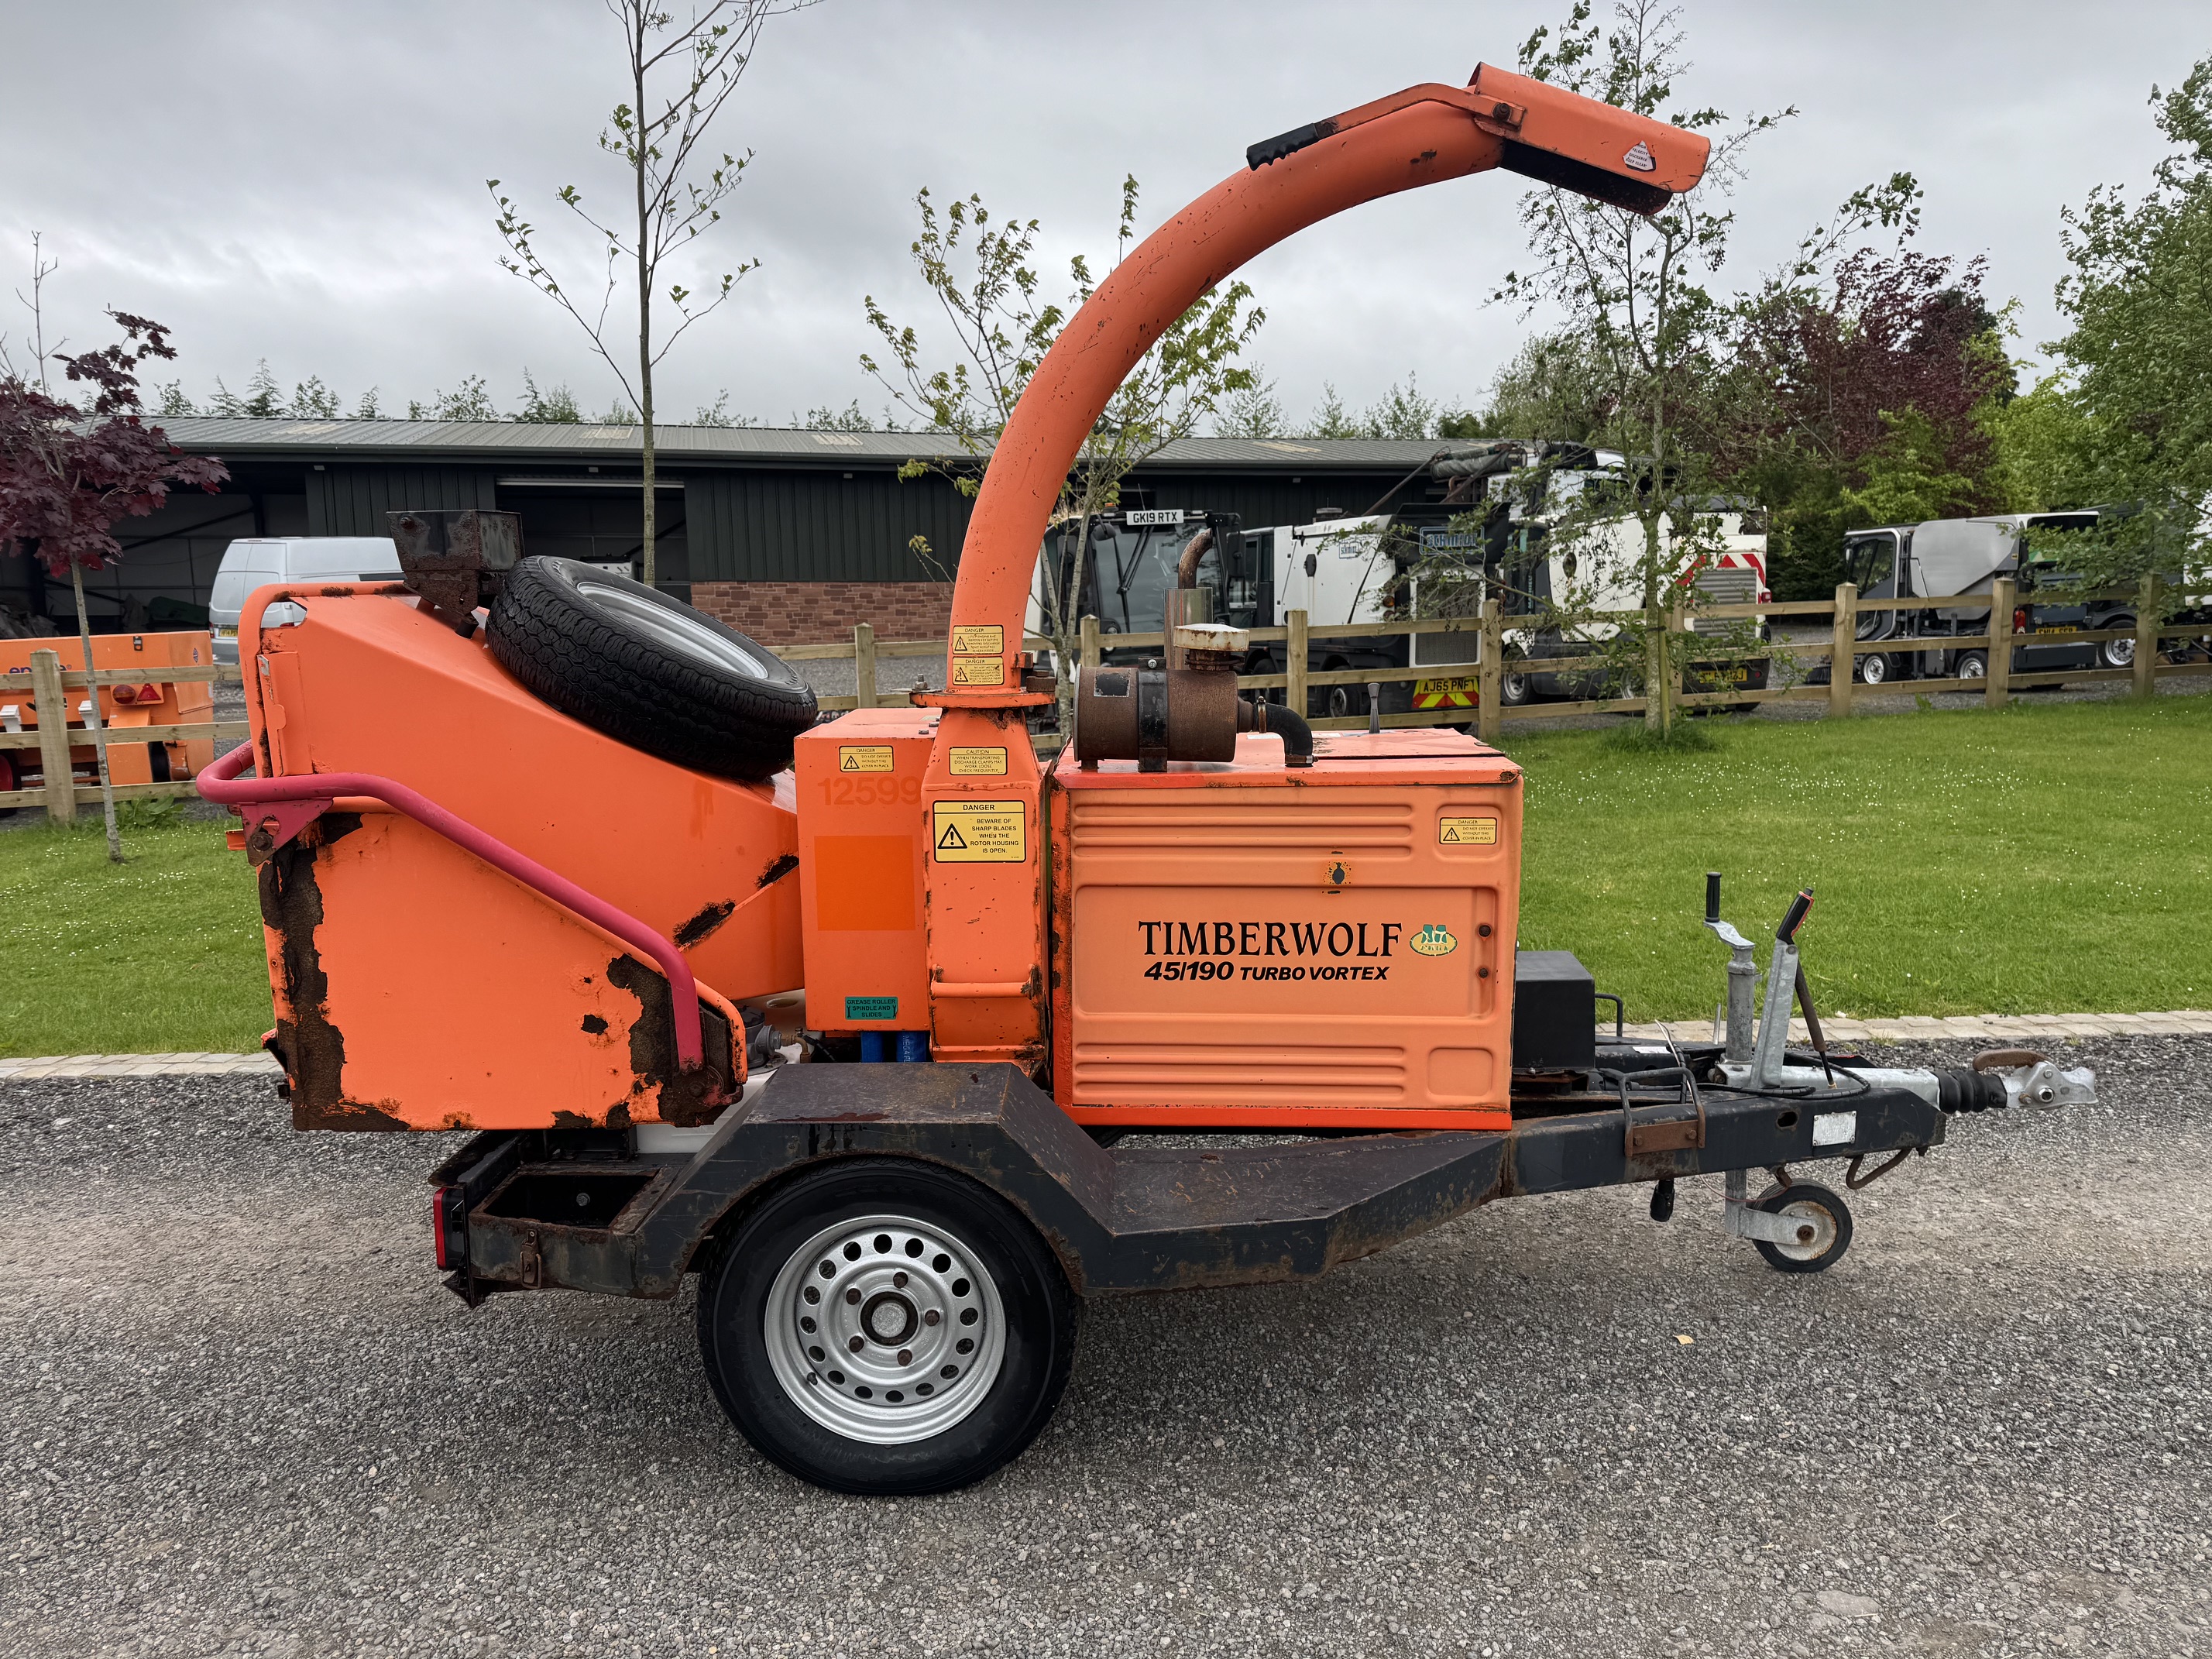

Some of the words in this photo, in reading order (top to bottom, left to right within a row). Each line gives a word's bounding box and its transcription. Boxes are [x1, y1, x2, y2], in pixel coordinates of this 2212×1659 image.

[1133, 512, 1156, 523] GK19
[1158, 512, 1177, 522] RTX
[1424, 681, 1449, 692] AJ65
[1451, 680, 1469, 691] PNF
[817, 776, 922, 806] 12599
[1138, 920, 1403, 957] TIMBERWOLF
[1144, 961, 1235, 981] 45/190
[1240, 966, 1306, 981] TURBO
[1309, 966, 1390, 981] VORTEX
